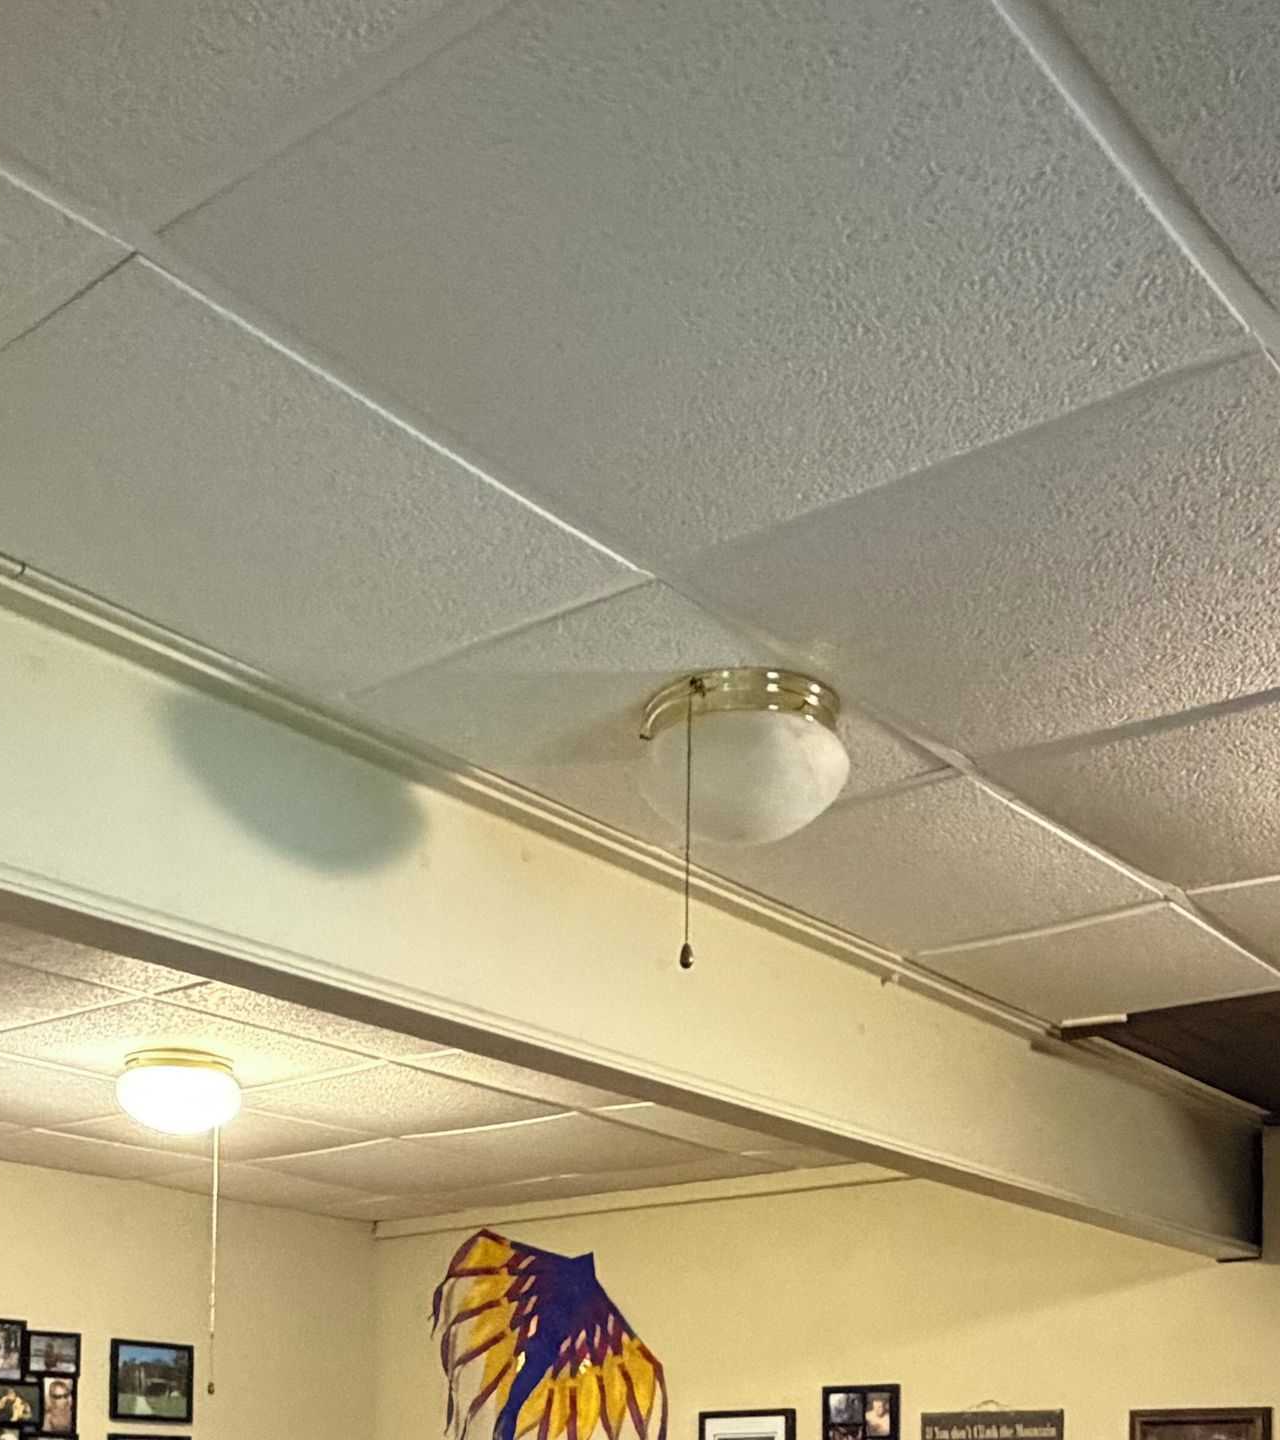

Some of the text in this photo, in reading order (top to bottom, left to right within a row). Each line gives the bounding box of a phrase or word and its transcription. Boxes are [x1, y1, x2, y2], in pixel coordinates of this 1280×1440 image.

[934, 1426, 950, 1440] You
[950, 1425, 972, 1440] don't
[999, 1424, 1015, 1439] the
[1015, 1422, 1057, 1438] Mountain
